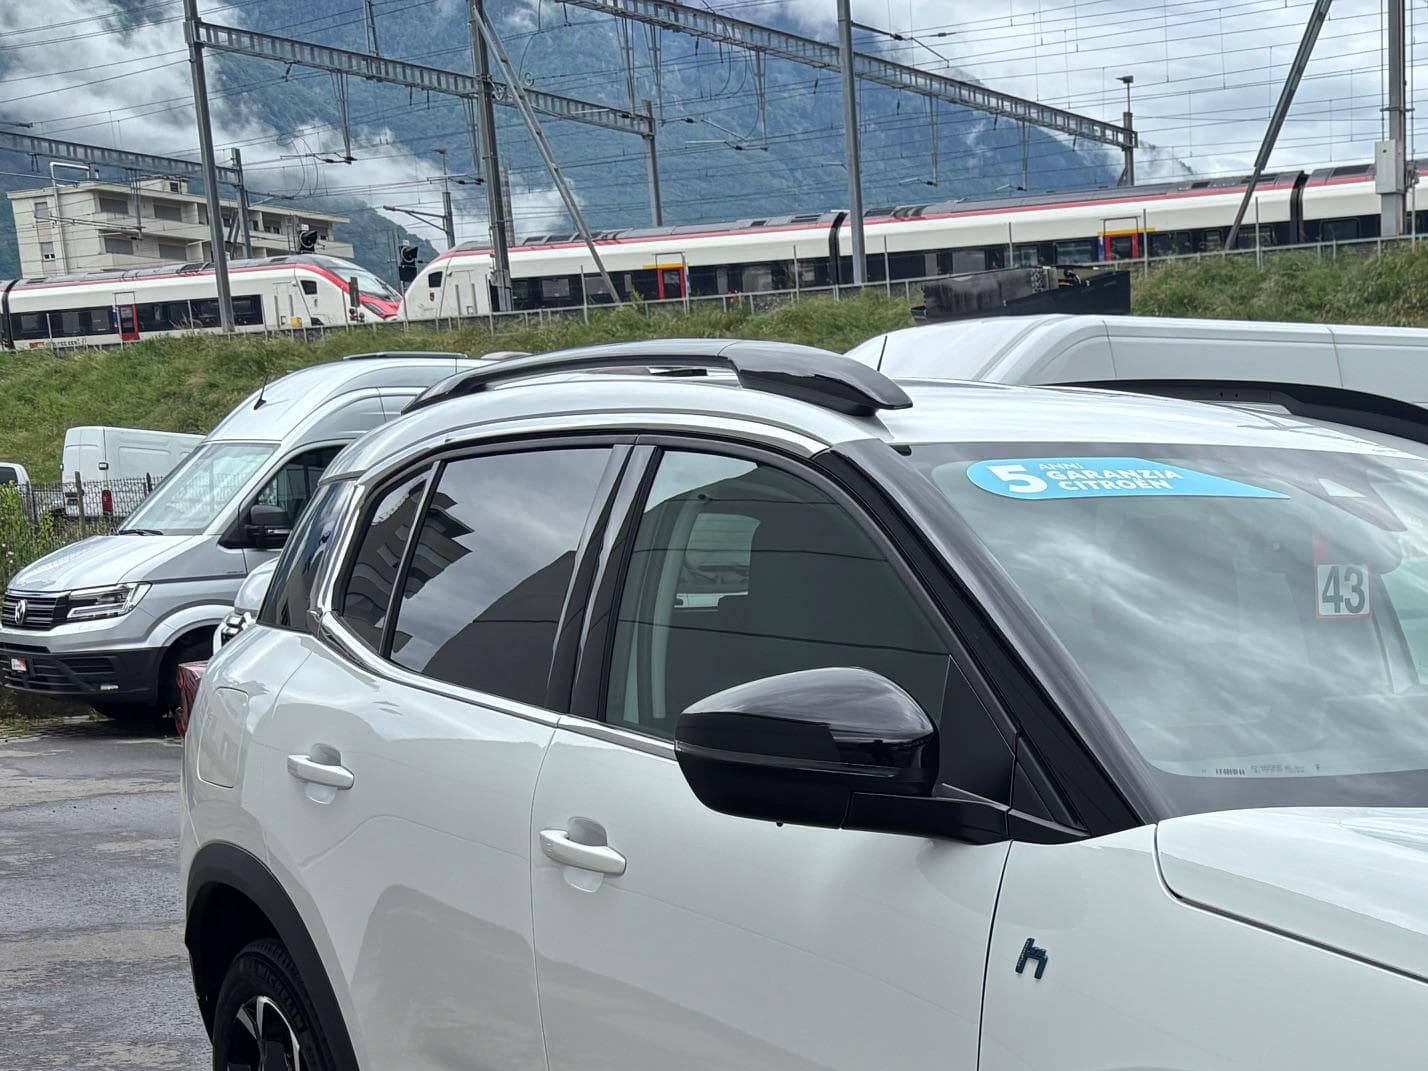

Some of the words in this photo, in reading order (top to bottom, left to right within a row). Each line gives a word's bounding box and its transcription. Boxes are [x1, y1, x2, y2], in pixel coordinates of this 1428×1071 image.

[1039, 463, 1084, 471] ANNI
[987, 464, 1048, 493] 5
[1046, 469, 1185, 481] GARANZIA
[1058, 477, 1174, 490] CITROËN
[1322, 566, 1365, 613] 43
